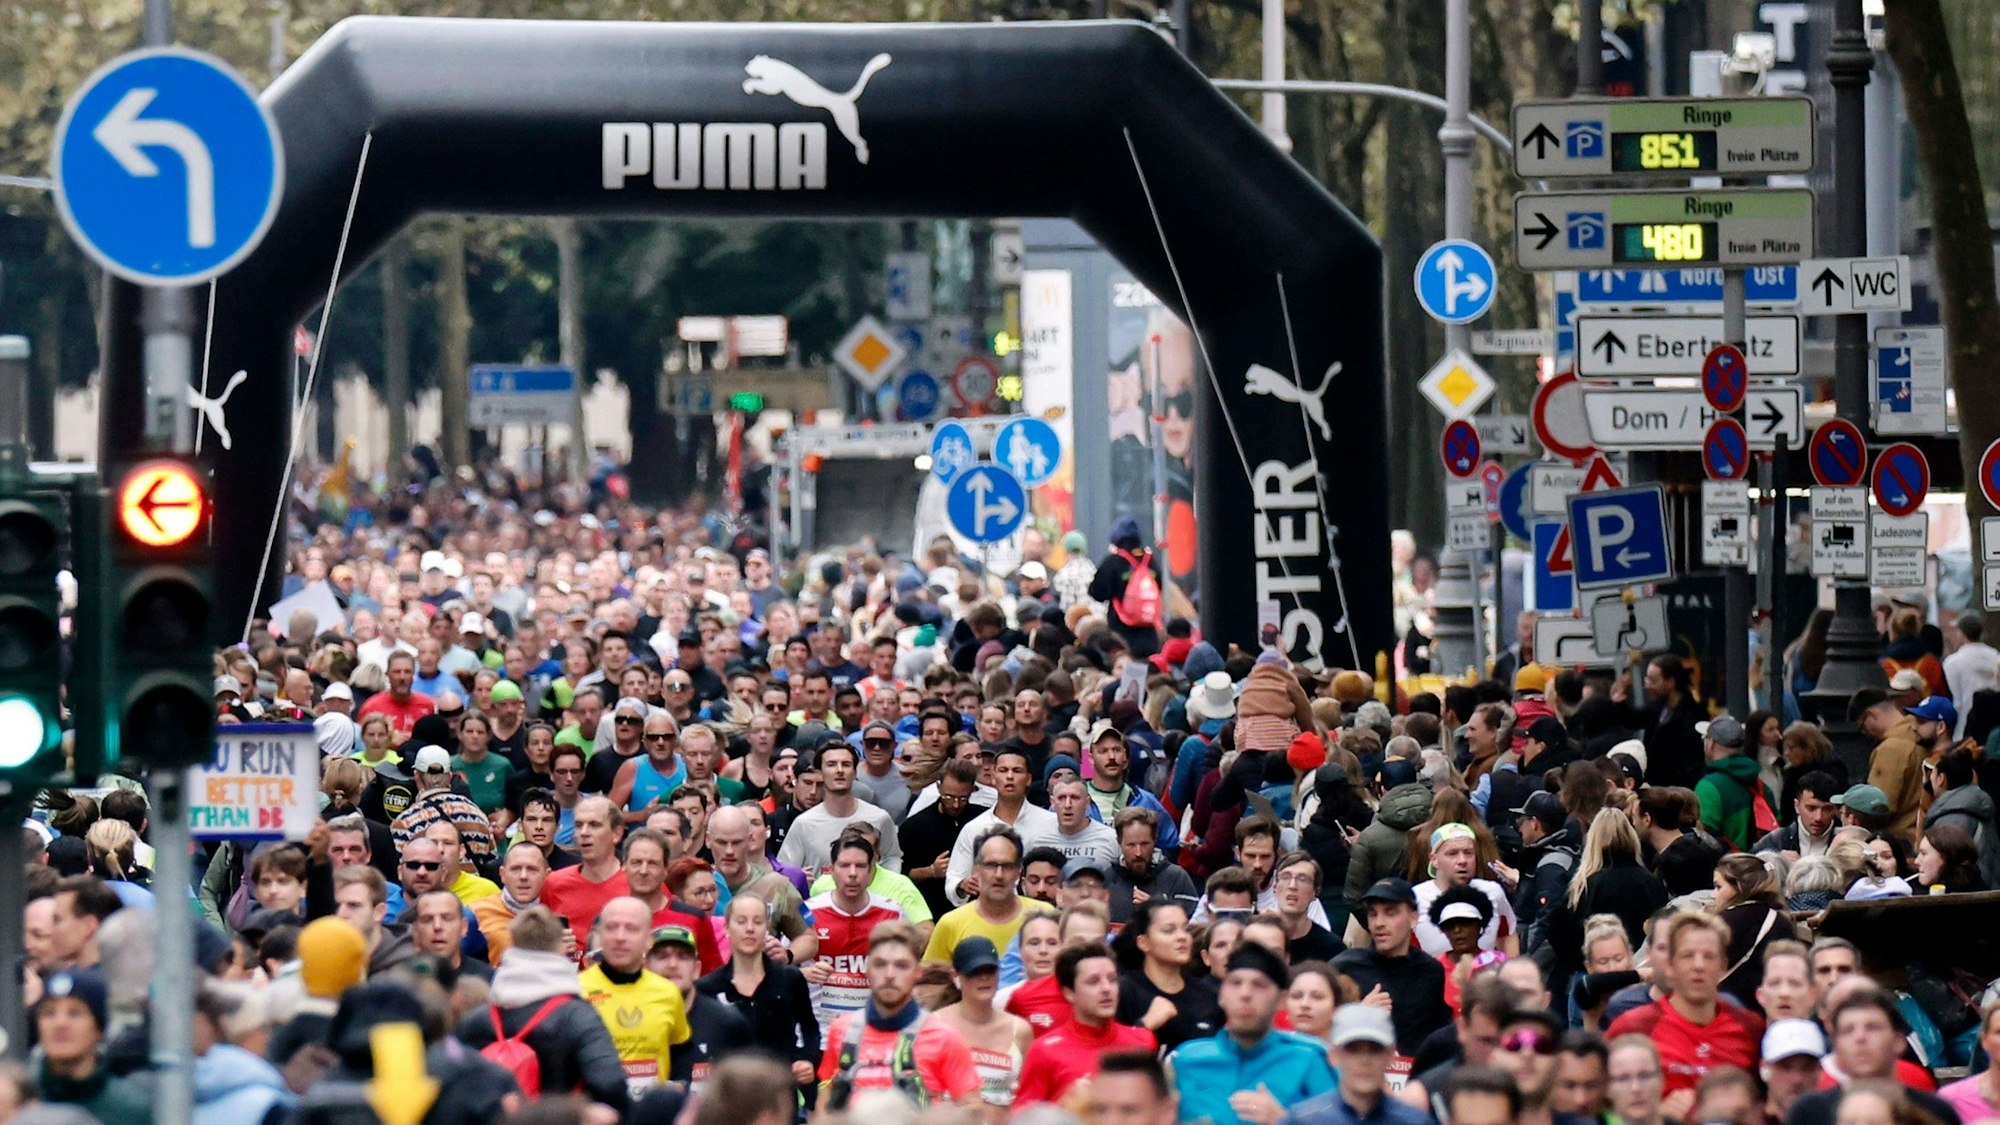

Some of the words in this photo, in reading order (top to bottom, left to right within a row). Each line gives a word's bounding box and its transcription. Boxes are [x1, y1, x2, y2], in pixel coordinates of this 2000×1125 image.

[1683, 105, 1732, 127] Ringe
[602, 122, 827, 190] PUMA
[1640, 133, 1699, 169] 851
[1727, 149, 1755, 162] freie
[1684, 196, 1733, 218] Ringe
[1642, 224, 1704, 260] 480
[1728, 241, 1756, 254] freie
[1853, 271, 1896, 297] WC
[1637, 333, 1774, 359] Eberttz
[1612, 405, 1668, 430] Dom
[1700, 404, 1717, 429] H
[1585, 504, 1635, 573] P
[1873, 526, 1923, 539] Ladezone
[1253, 458, 1325, 675] STER
[240, 741, 296, 774] RUN
[206, 777, 296, 805] BETTER
[189, 806, 250, 828] THAN
[1084, 847, 1097, 857] IT
[819, 955, 871, 974] REW
